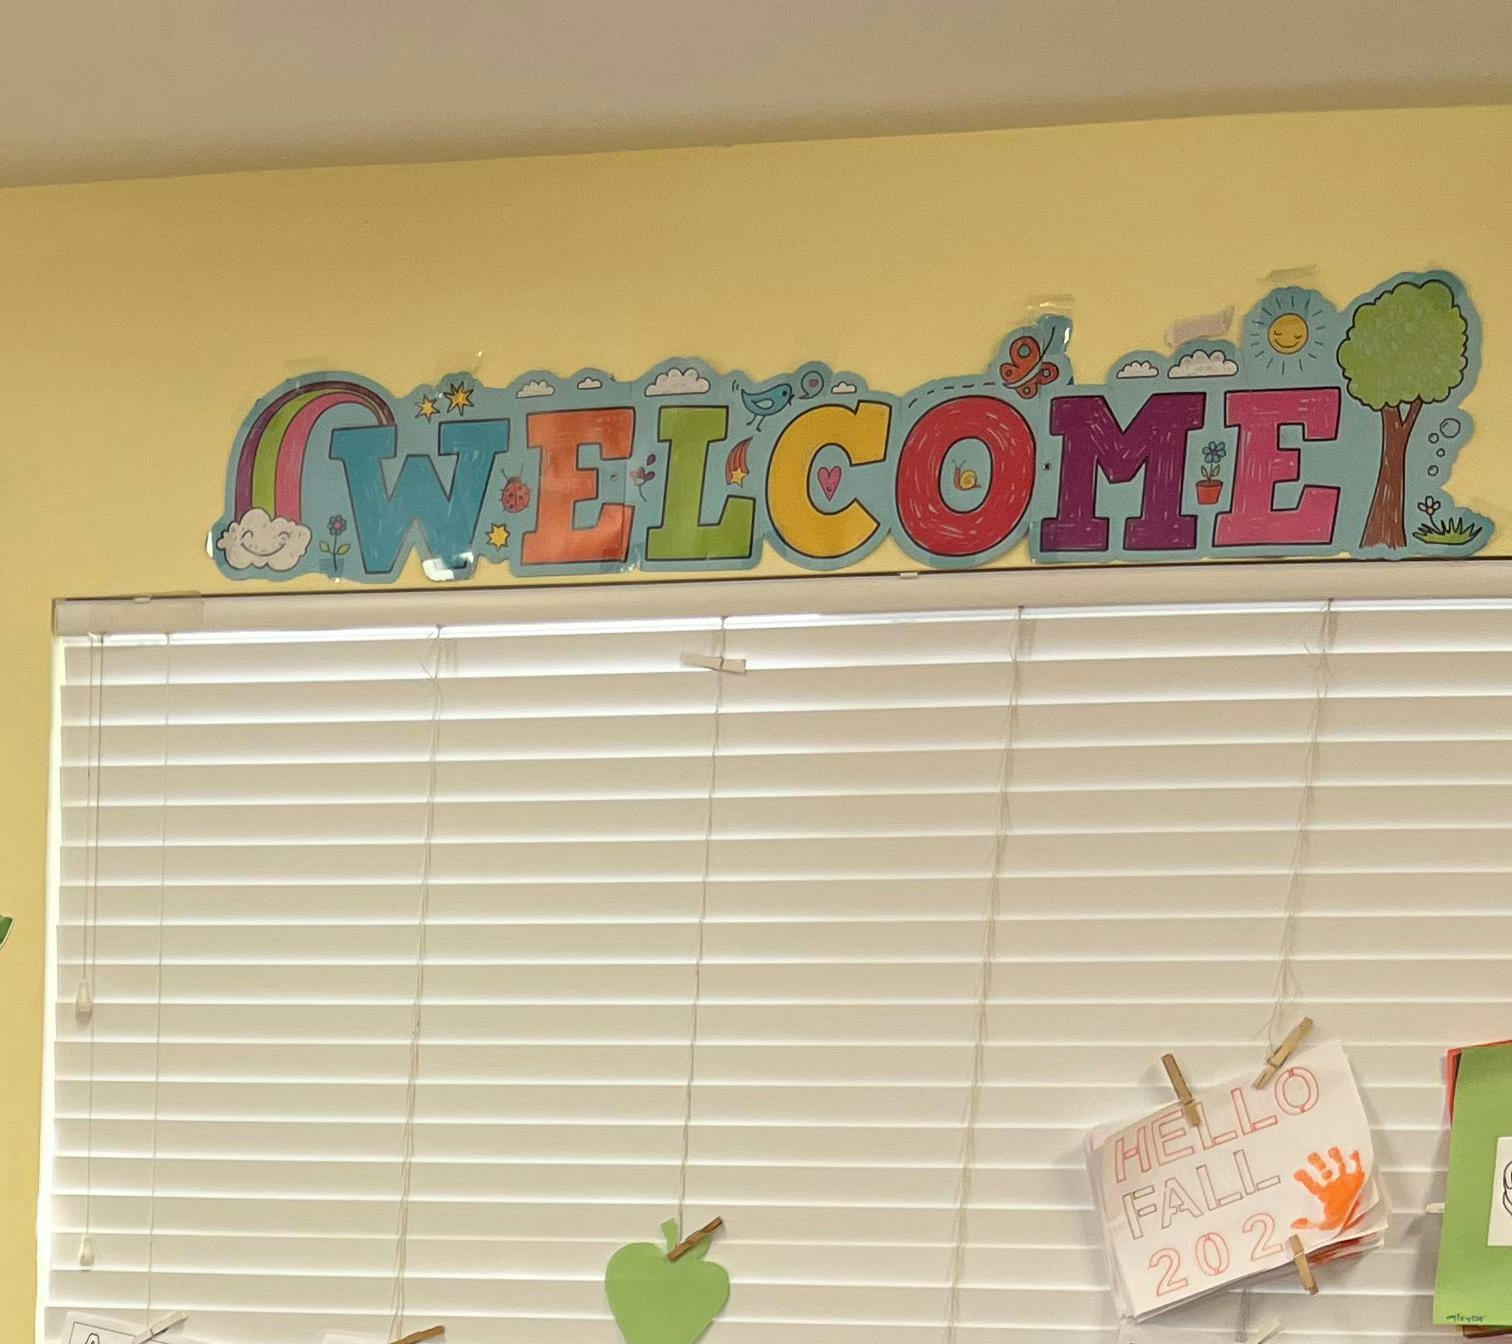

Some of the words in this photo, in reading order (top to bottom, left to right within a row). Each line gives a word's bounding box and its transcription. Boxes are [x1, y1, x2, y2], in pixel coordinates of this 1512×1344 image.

[329, 386, 1341, 574] WELCOME
[1113, 1066, 1320, 1184] HELLO
[1121, 1149, 1281, 1239] FALL
